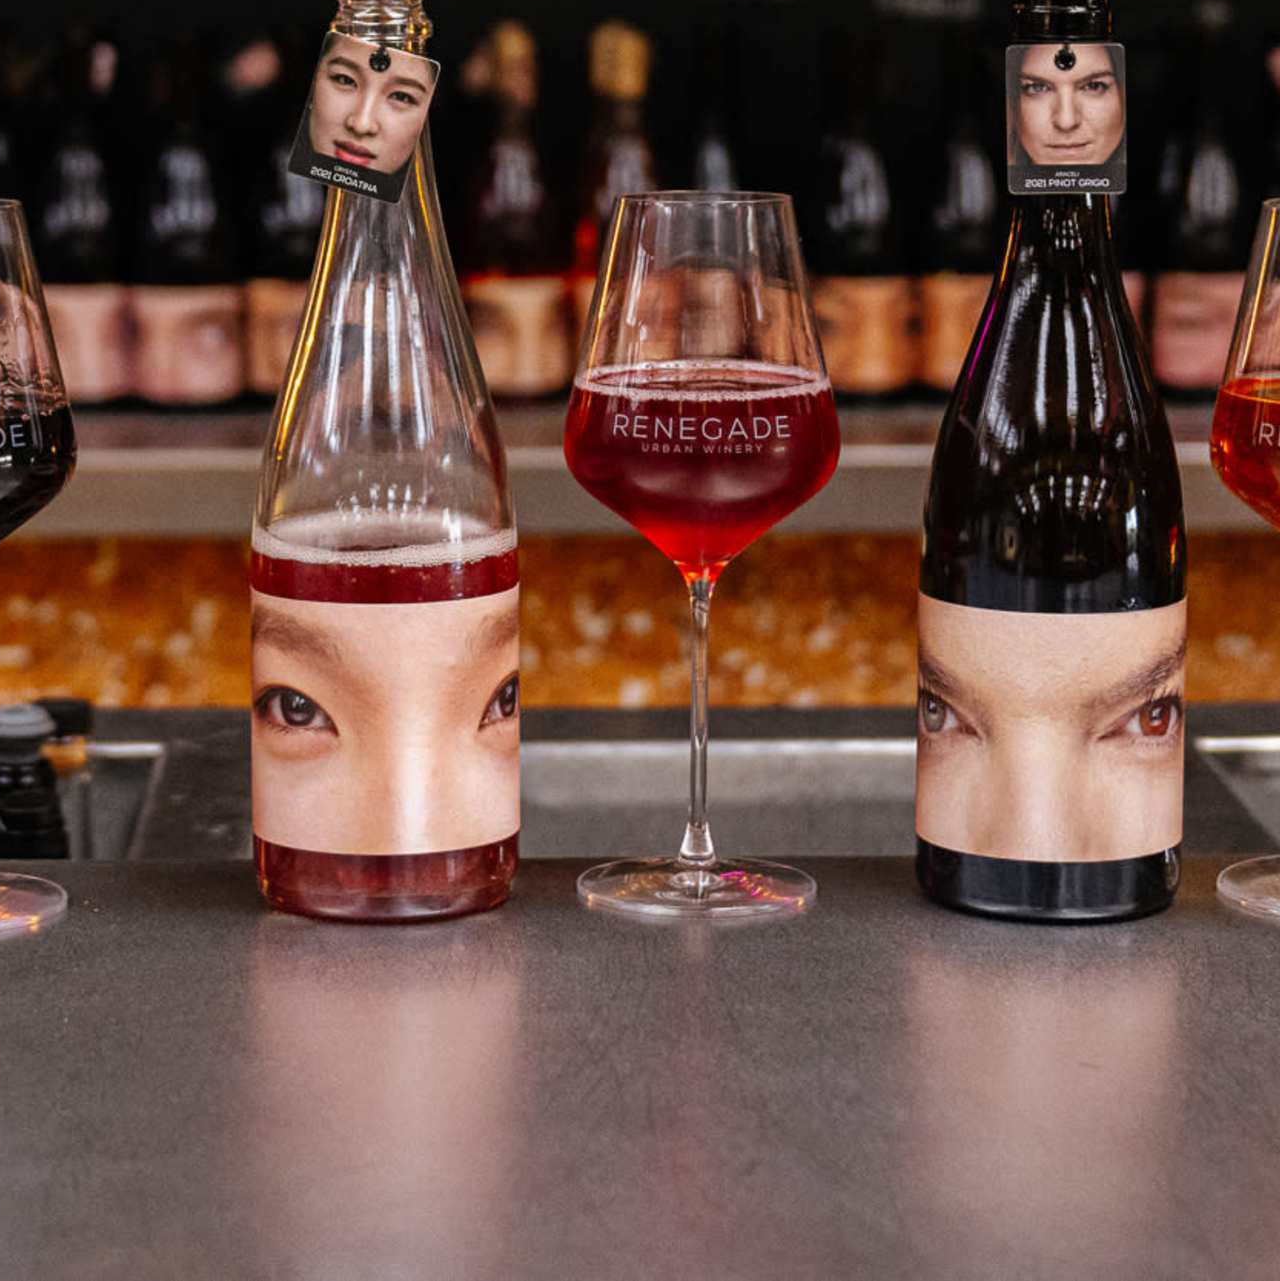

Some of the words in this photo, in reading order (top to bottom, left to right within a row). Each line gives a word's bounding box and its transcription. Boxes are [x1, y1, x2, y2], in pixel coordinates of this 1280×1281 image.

[310, 166, 332, 180] 2021
[332, 171, 378, 194] CROATINA
[1024, 179, 1047, 188] 2021
[1048, 179, 1076, 188] PINOT
[1078, 178, 1110, 188] GRIGIO
[610, 413, 792, 441] RENEGADE
[641, 444, 694, 454] URBAN
[702, 444, 764, 454] WINERY
